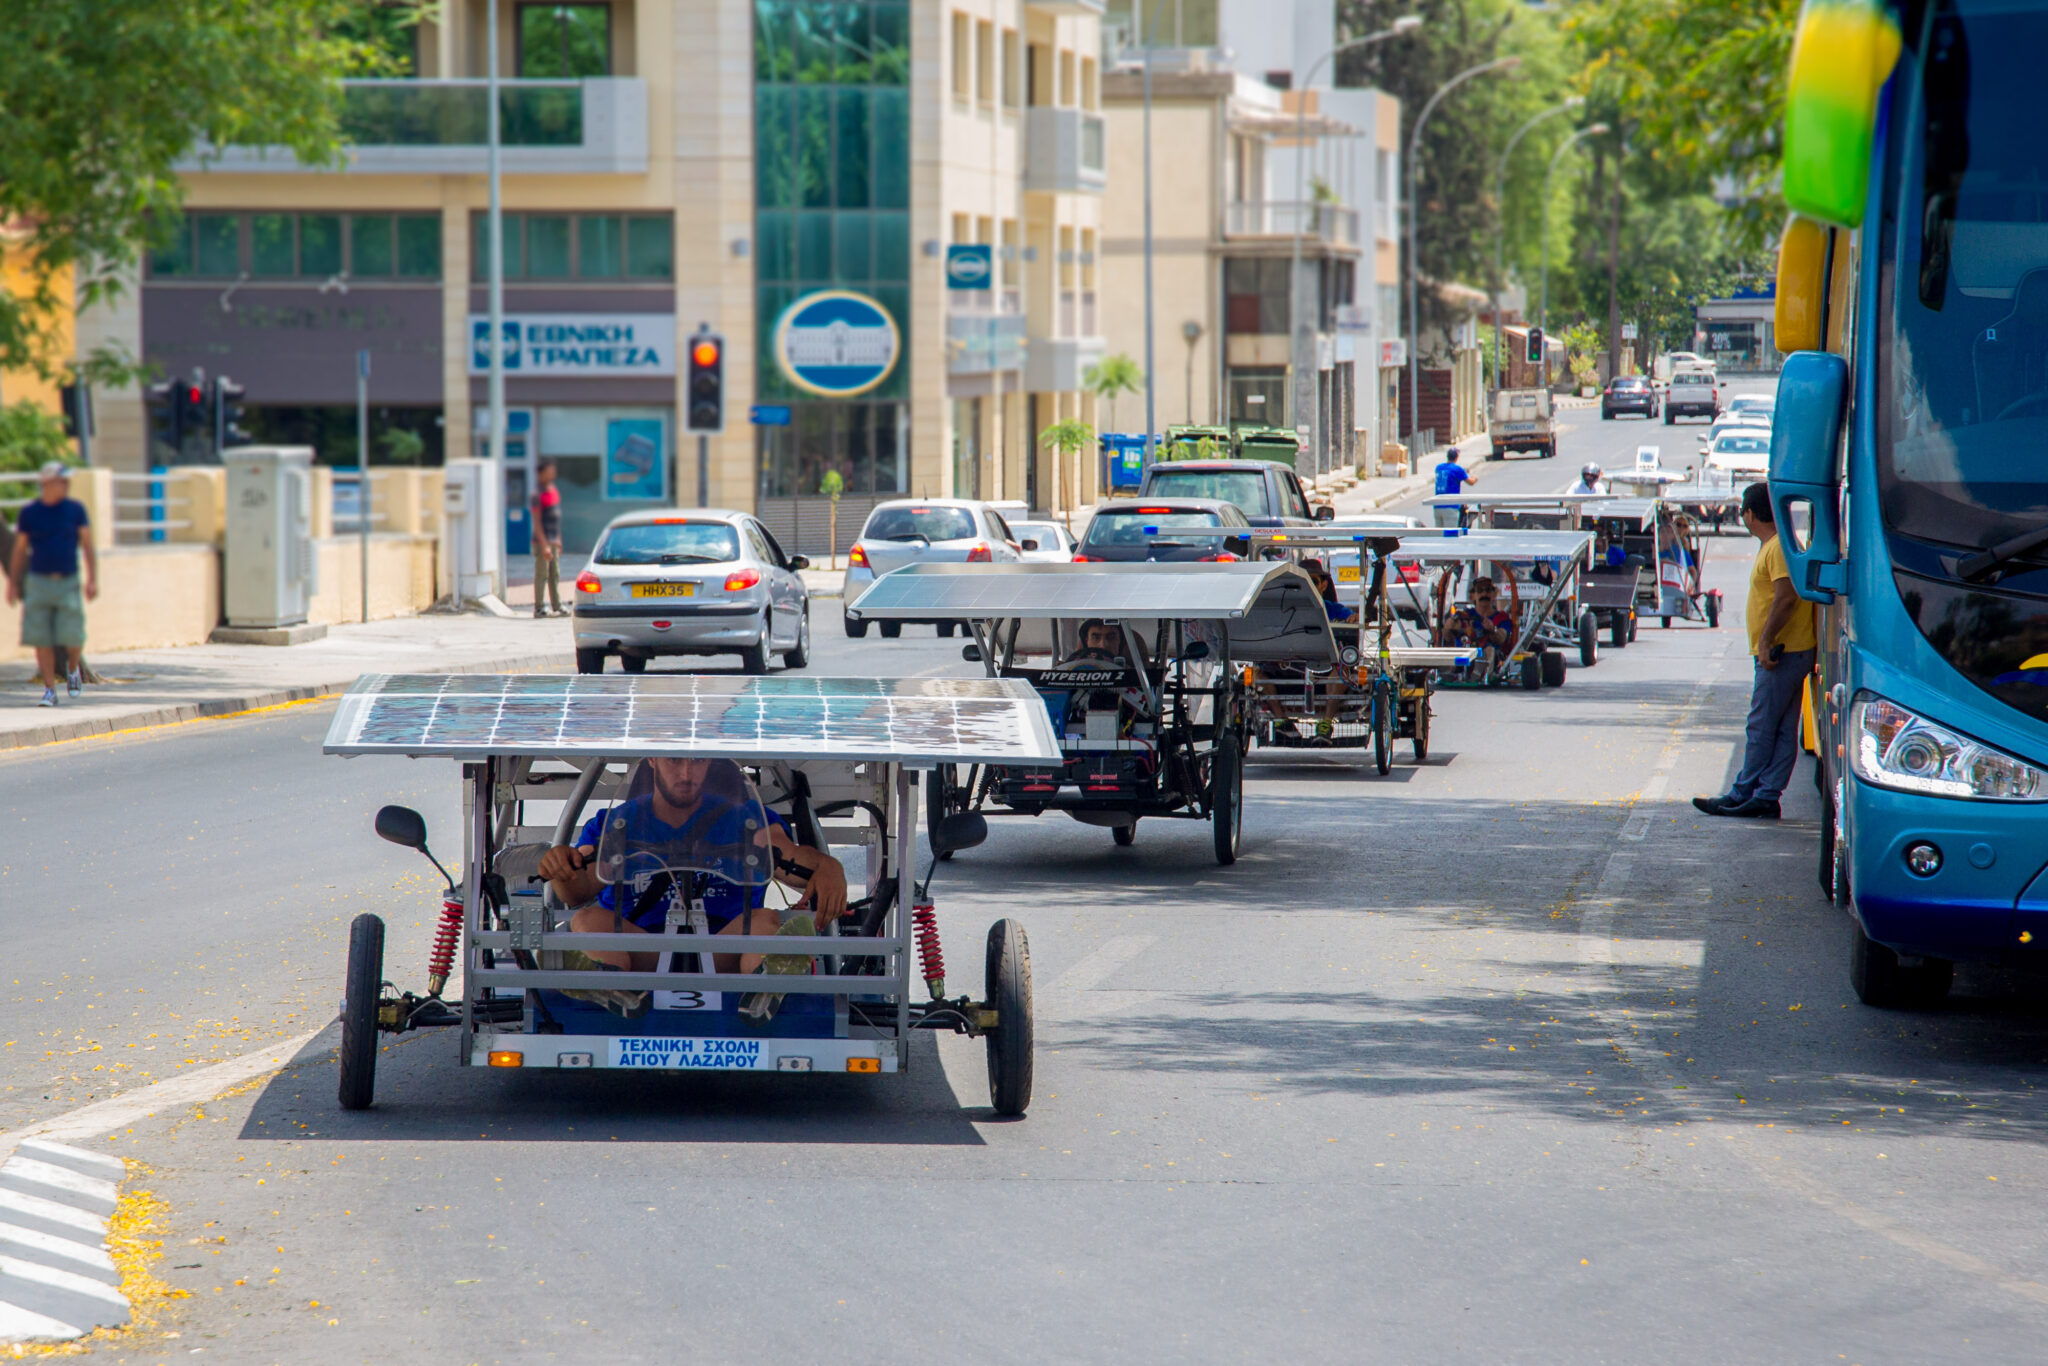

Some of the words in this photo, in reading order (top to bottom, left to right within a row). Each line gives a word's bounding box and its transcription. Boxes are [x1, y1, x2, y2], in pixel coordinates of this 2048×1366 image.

[526, 323, 633, 344] ΕΘΝΙΚΗ
[528, 346, 660, 367] ΤΡΑΠΕΖΑ
[1039, 671, 1113, 682] HYPERION
[669, 990, 706, 1009] 3
[619, 1039, 693, 1052] ΤΕΧΝΙΚΗ
[703, 1040, 759, 1054] ΣΧΟΛΗ
[619, 1054, 670, 1066] ΑΓΙΟΥ
[678, 1054, 758, 1068] ΛΑΖΑΡΟΥ
